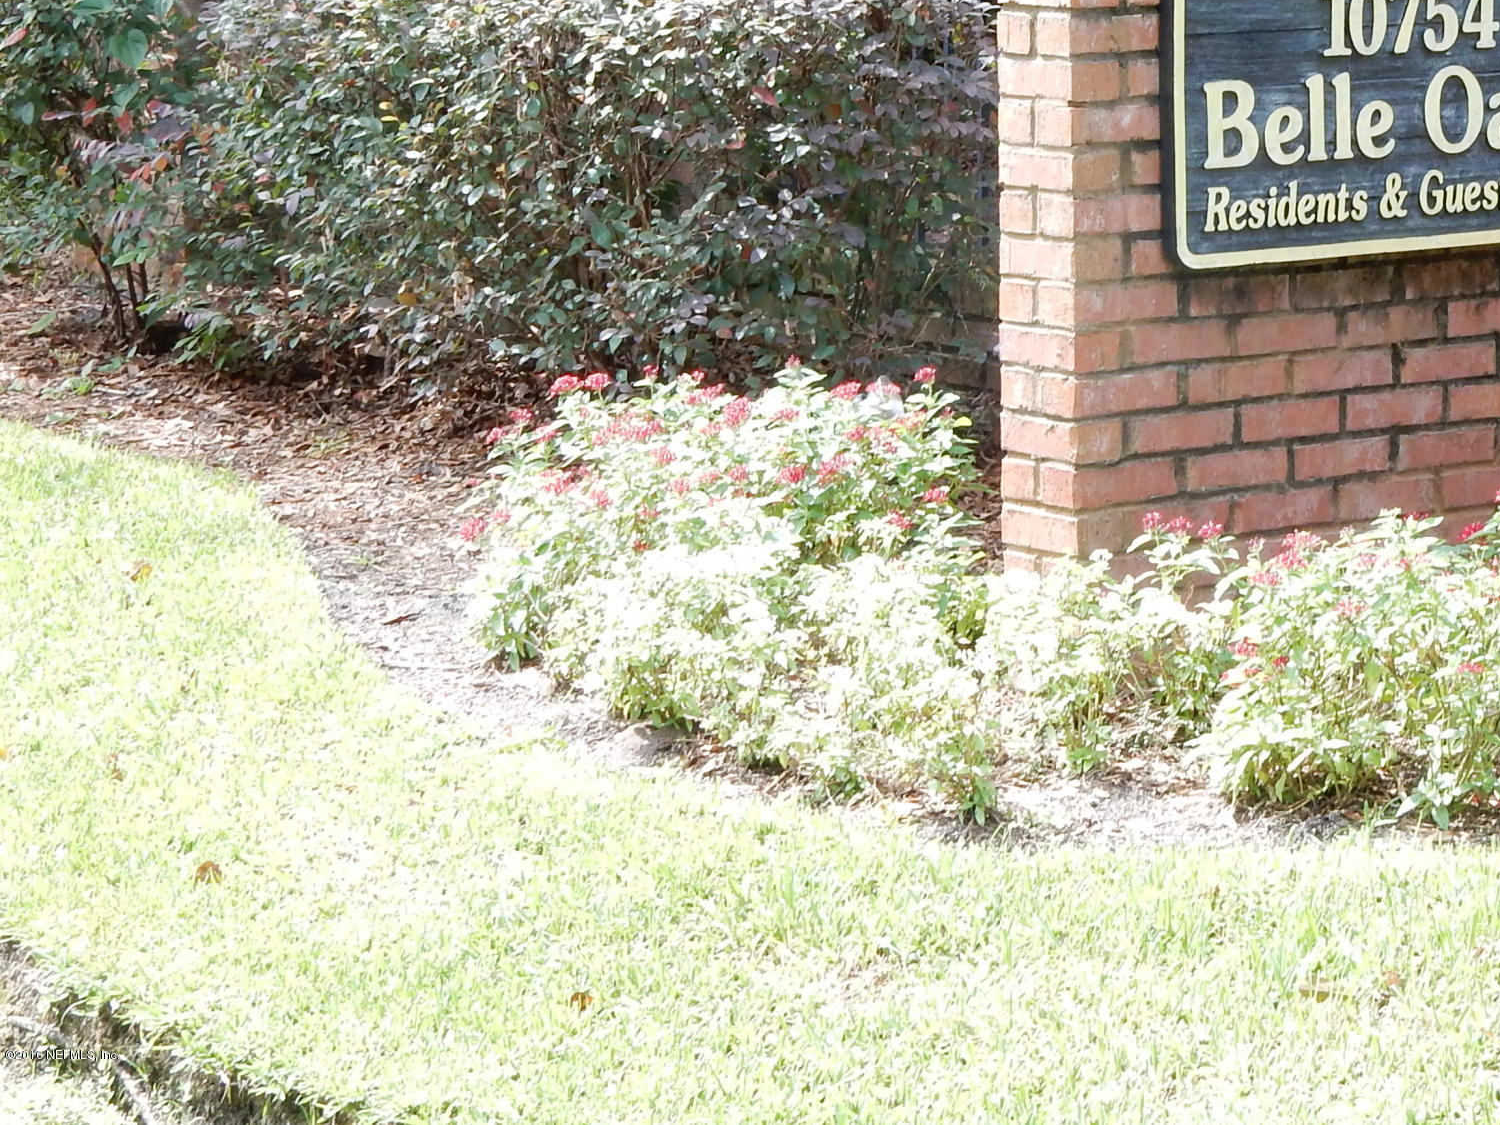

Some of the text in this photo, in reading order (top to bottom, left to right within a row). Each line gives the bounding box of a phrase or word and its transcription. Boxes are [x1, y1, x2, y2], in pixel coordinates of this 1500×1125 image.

[1203, 72, 1395, 170] Belle
[1204, 180, 1368, 232] Residents
[1379, 172, 1408, 219] &
